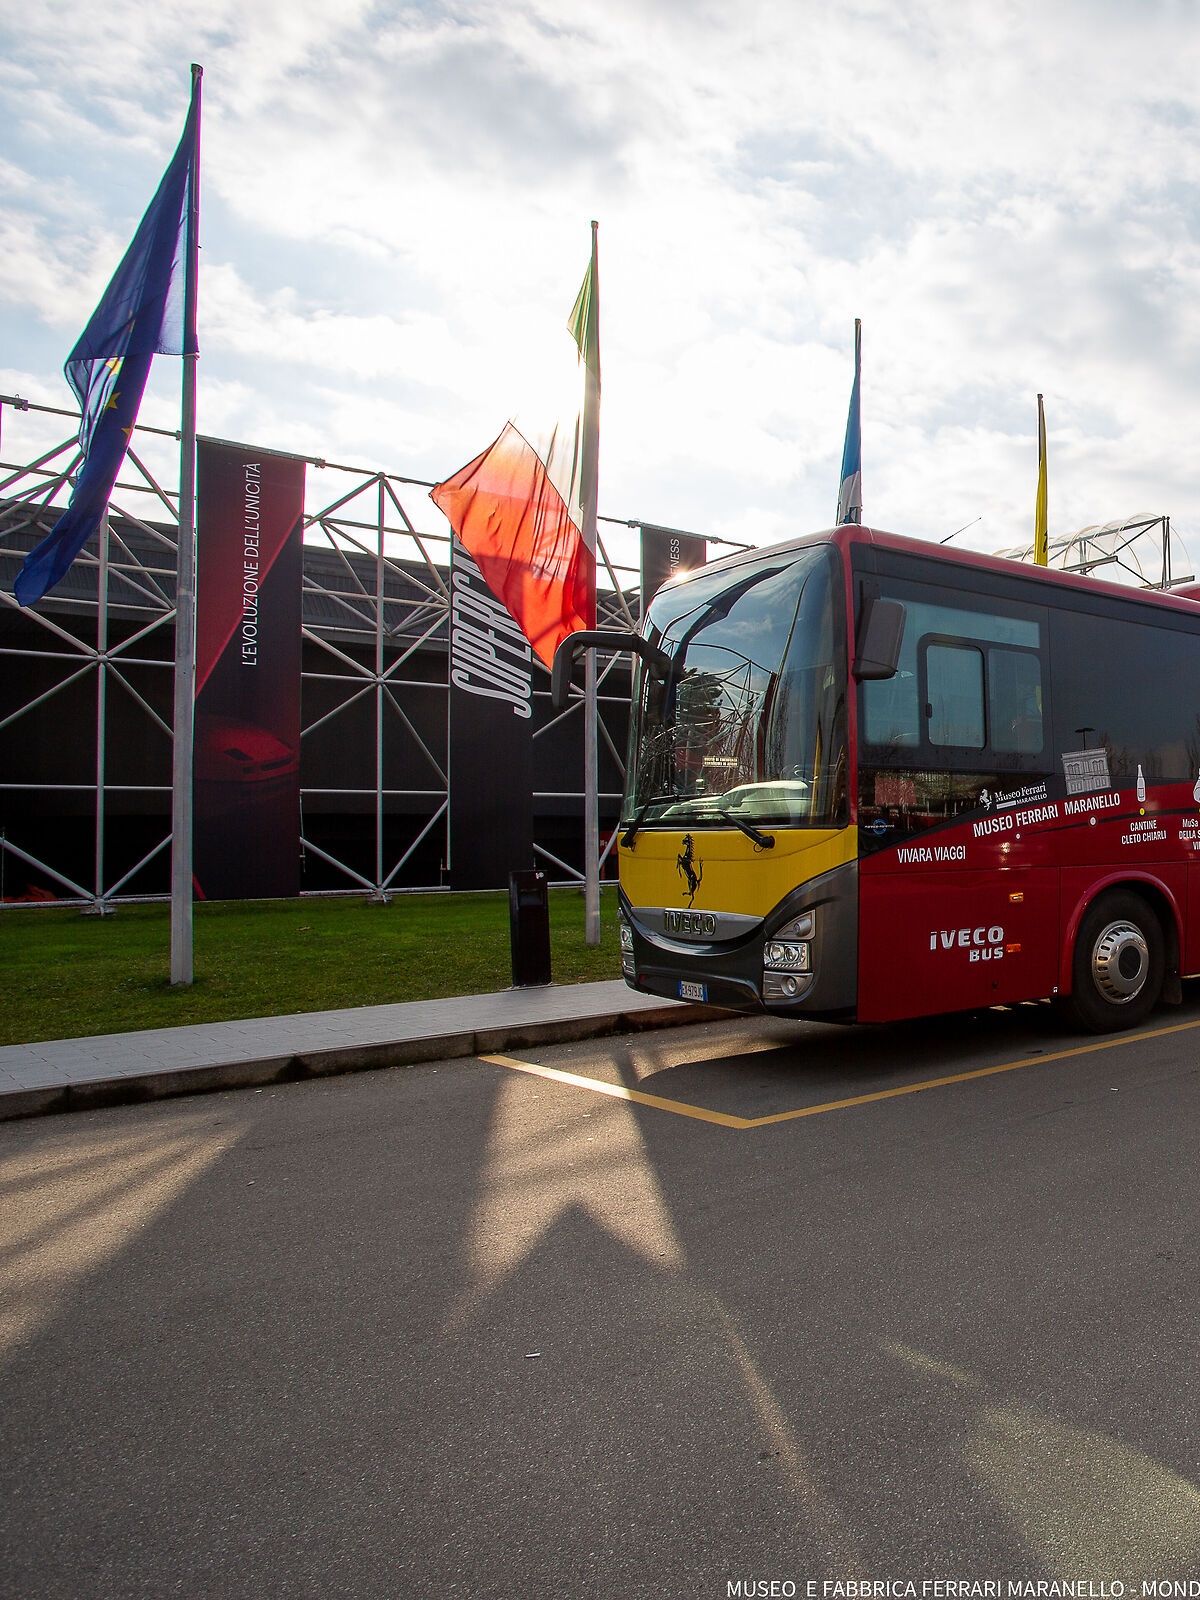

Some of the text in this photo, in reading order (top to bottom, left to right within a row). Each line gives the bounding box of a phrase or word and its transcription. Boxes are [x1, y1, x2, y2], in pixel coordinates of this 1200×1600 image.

[241, 463, 261, 666] L'EVOLUZIONE DELL'UNICITÀ
[452, 533, 532, 719] SUPERC
[994, 782, 1046, 803] Museo Ferrari
[1016, 793, 1048, 805] MARANELLO
[973, 793, 1121, 838] MUSEO FERRARI MARANELLO
[1130, 819, 1157, 832] CANTINE
[1178, 830, 1196, 840] DELLA
[1121, 830, 1167, 845] CLETO CHIARLI
[897, 846, 966, 864] VIVARA VIAGGI
[664, 911, 717, 937] IVECO
[930, 926, 1004, 951] IVECO
[969, 946, 1004, 962] BUS
